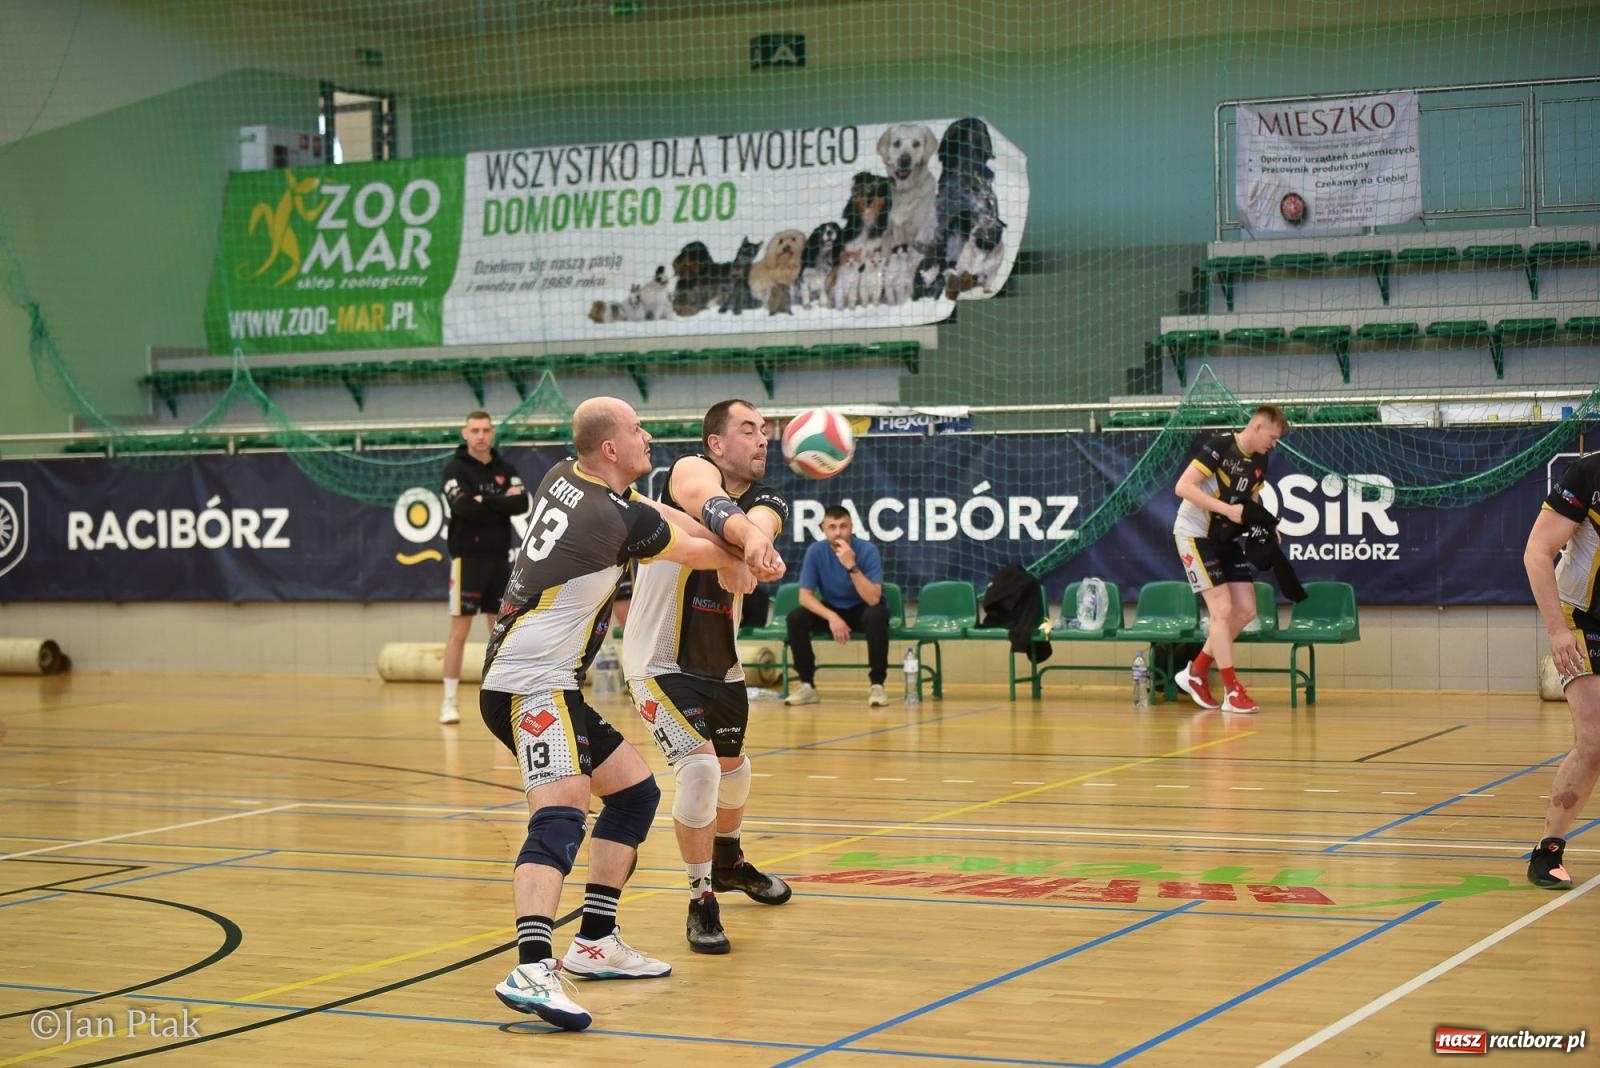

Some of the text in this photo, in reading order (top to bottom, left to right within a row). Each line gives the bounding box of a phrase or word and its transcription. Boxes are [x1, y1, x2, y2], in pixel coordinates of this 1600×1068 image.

[1257, 102, 1396, 138] MIESZKO
[485, 125, 860, 192] WSZYSTKO DLA TWOJEGO
[1260, 154, 1302, 163] Operator
[1305, 152, 1348, 164] urządzeń
[1261, 160, 1370, 174] Pracownik produkcyjny
[1315, 173, 1409, 189] Czekamy na Ciebie!
[316, 178, 441, 230] ZOO
[482, 181, 737, 238] DOMOWEGO ZOO
[300, 227, 432, 275] MAR
[296, 273, 428, 290] sklep zoologiczny
[519, 278, 537, 290] od
[575, 275, 606, 288] roku
[229, 301, 418, 340] WWW.ZOO-MAR.PL
[549, 476, 585, 509] ENTER
[1236, 477, 1249, 493] 10
[67, 496, 291, 551] RACIBÓRZ
[520, 496, 569, 562] 13
[1290, 538, 1400, 561] RACIBÓRZ
[526, 741, 550, 772] 13
